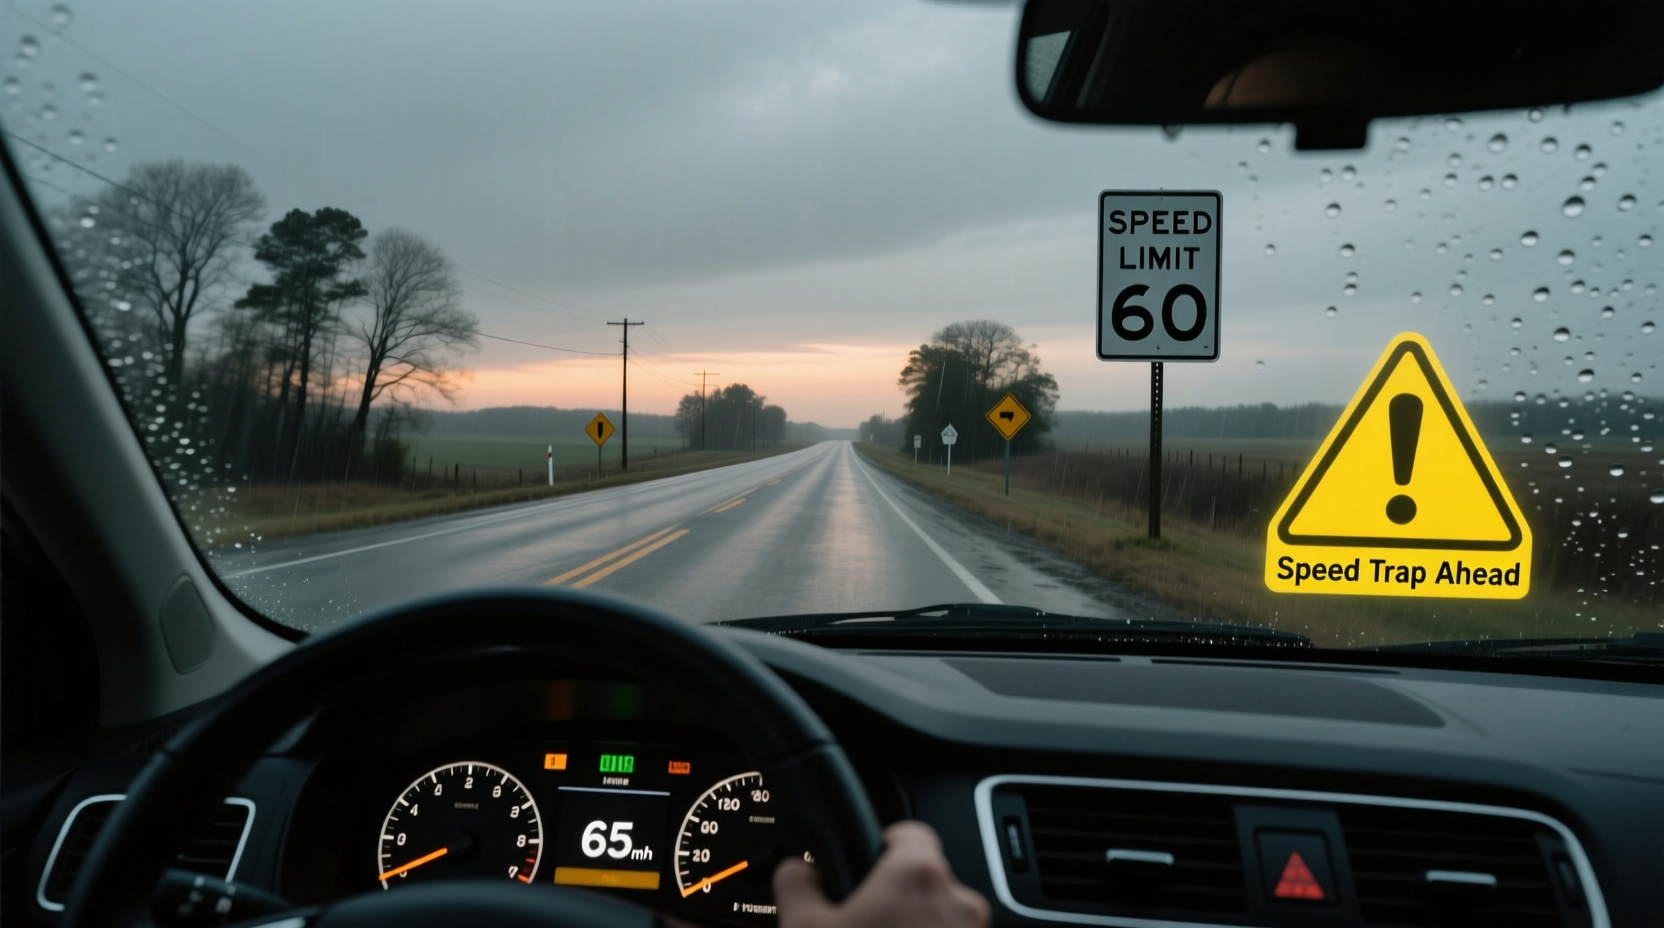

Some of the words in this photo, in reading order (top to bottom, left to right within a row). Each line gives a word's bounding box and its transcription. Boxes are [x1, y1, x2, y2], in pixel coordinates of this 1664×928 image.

[1108, 207, 1213, 236] SPEED
[1119, 245, 1201, 272] LIMIT
[1110, 282, 1208, 343] 60
[692, 848, 711, 863] 20
